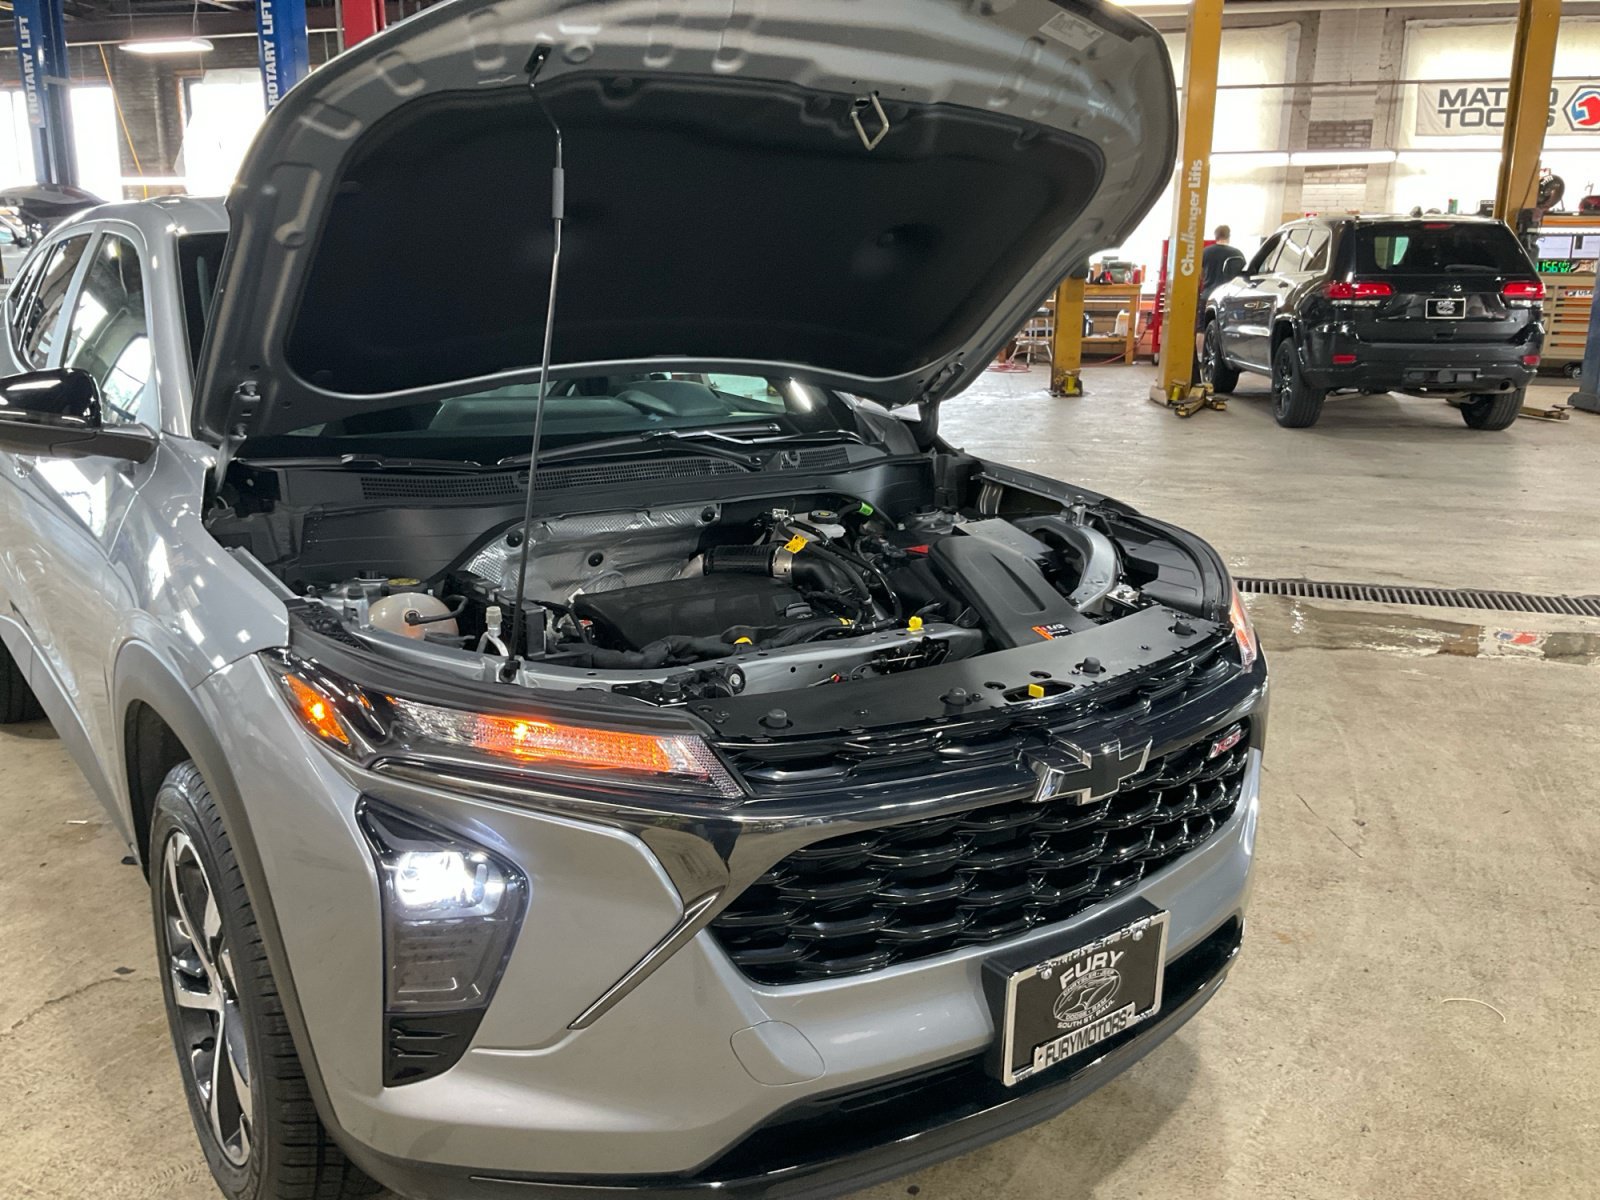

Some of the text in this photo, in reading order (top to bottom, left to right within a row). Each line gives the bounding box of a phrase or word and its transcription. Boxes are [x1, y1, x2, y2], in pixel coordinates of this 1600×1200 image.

[19, 16, 39, 113] ROTARY LIFT
[260, 0, 280, 106] ROTARY LIFT
[1438, 87, 1559, 108] MAT
[1437, 107, 1556, 128] TOO
[1180, 159, 1202, 276] Challenger Lifts
[1059, 950, 1124, 989] FURY
[1056, 1020, 1083, 1029] SOUTH
[1096, 1000, 1115, 1017] PAUL
